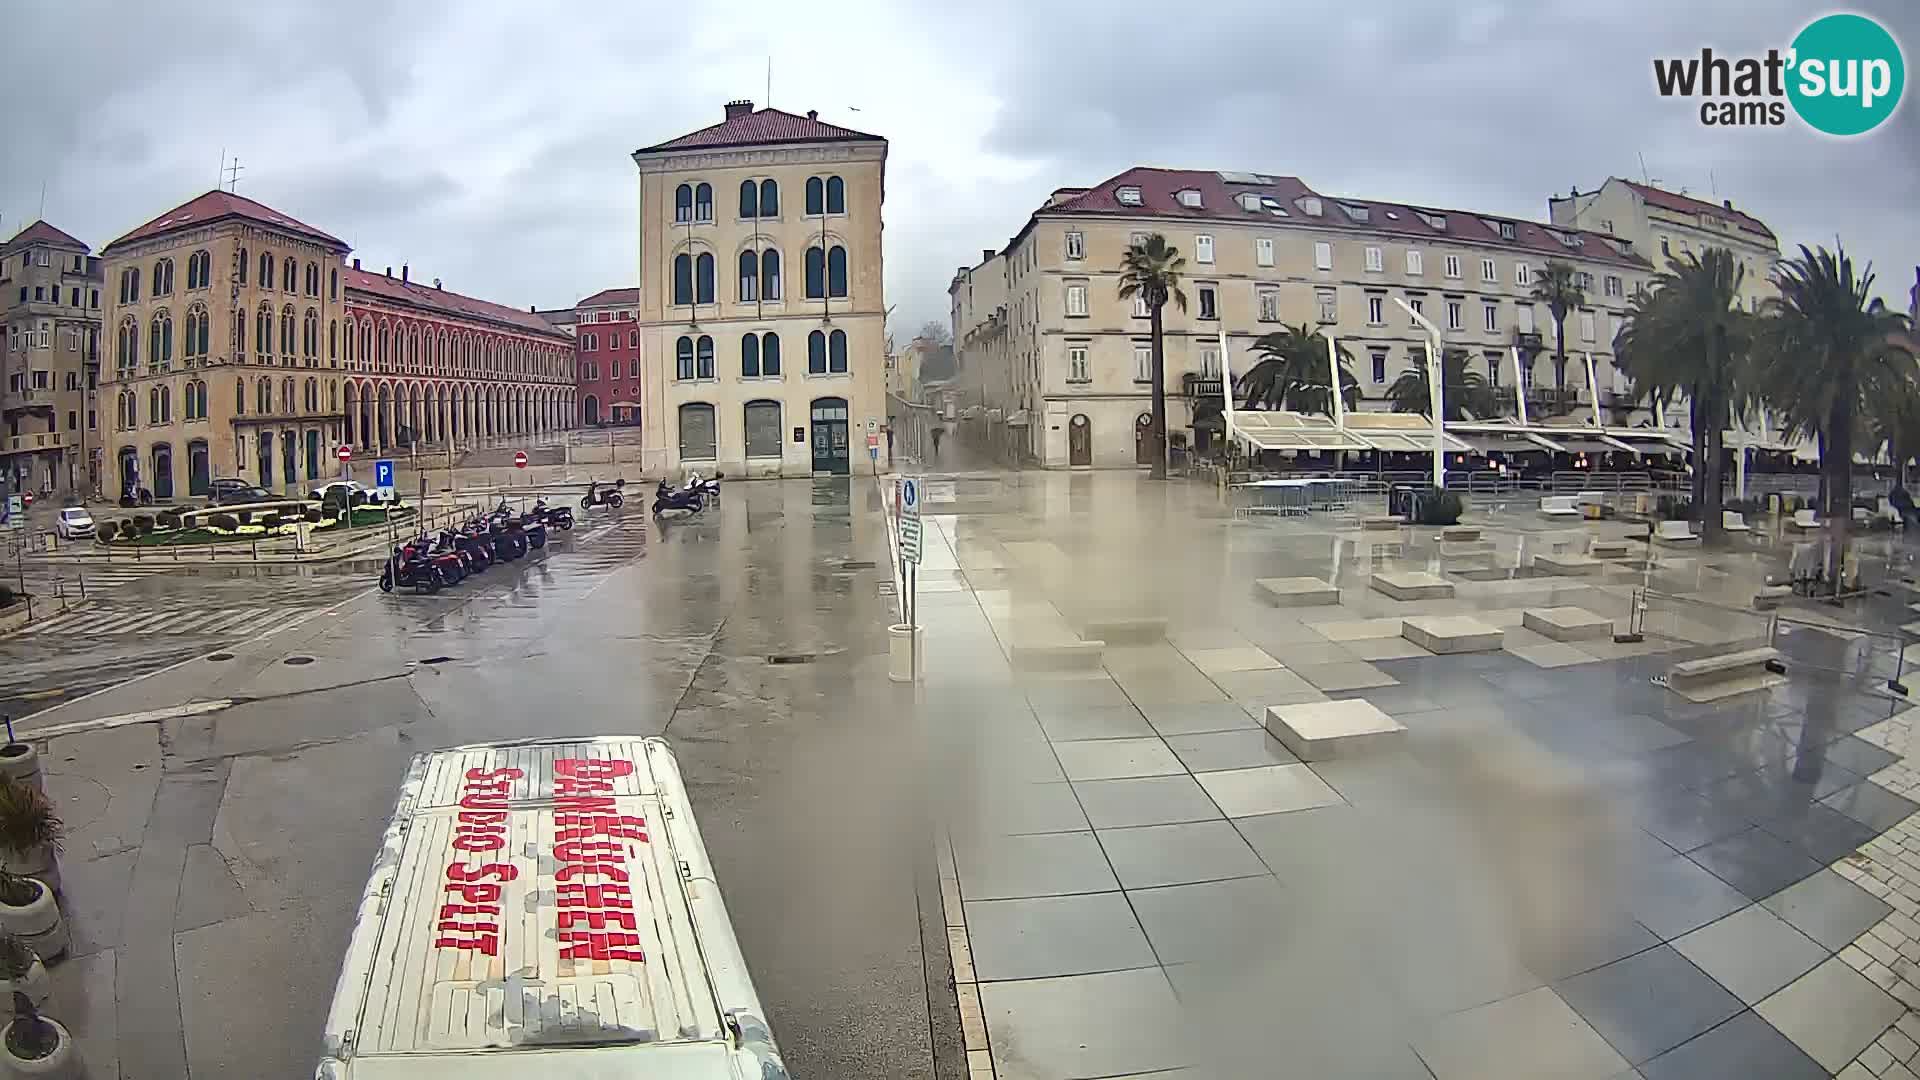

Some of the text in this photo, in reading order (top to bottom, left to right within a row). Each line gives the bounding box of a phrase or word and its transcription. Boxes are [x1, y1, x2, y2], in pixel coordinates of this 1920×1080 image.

[380, 465, 389, 483] P
[434, 767, 524, 957] STUDIO SPLIT
